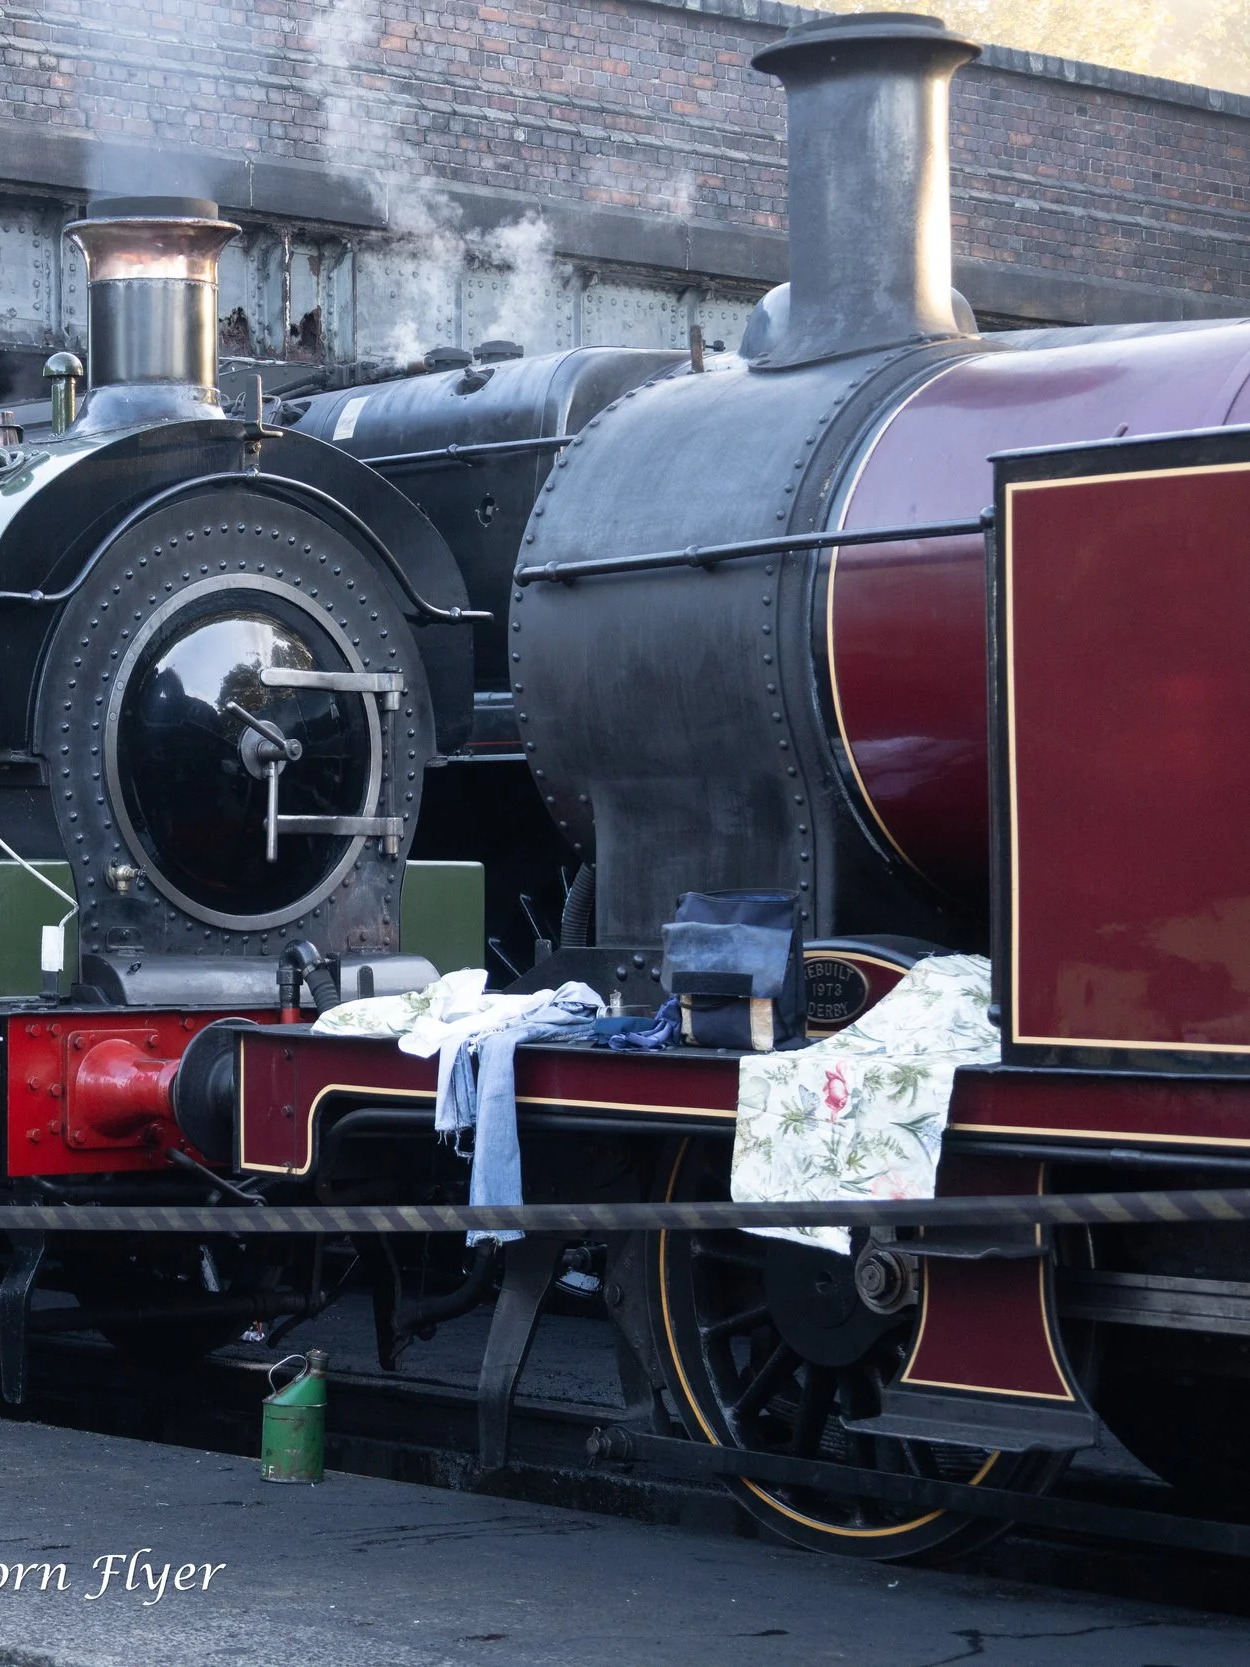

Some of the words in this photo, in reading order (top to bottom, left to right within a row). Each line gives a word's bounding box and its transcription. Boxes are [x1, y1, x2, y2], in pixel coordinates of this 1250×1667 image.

[805, 963, 854, 981] EBUILT
[813, 984, 842, 996] 1973
[808, 1002, 848, 1017] DERBY
